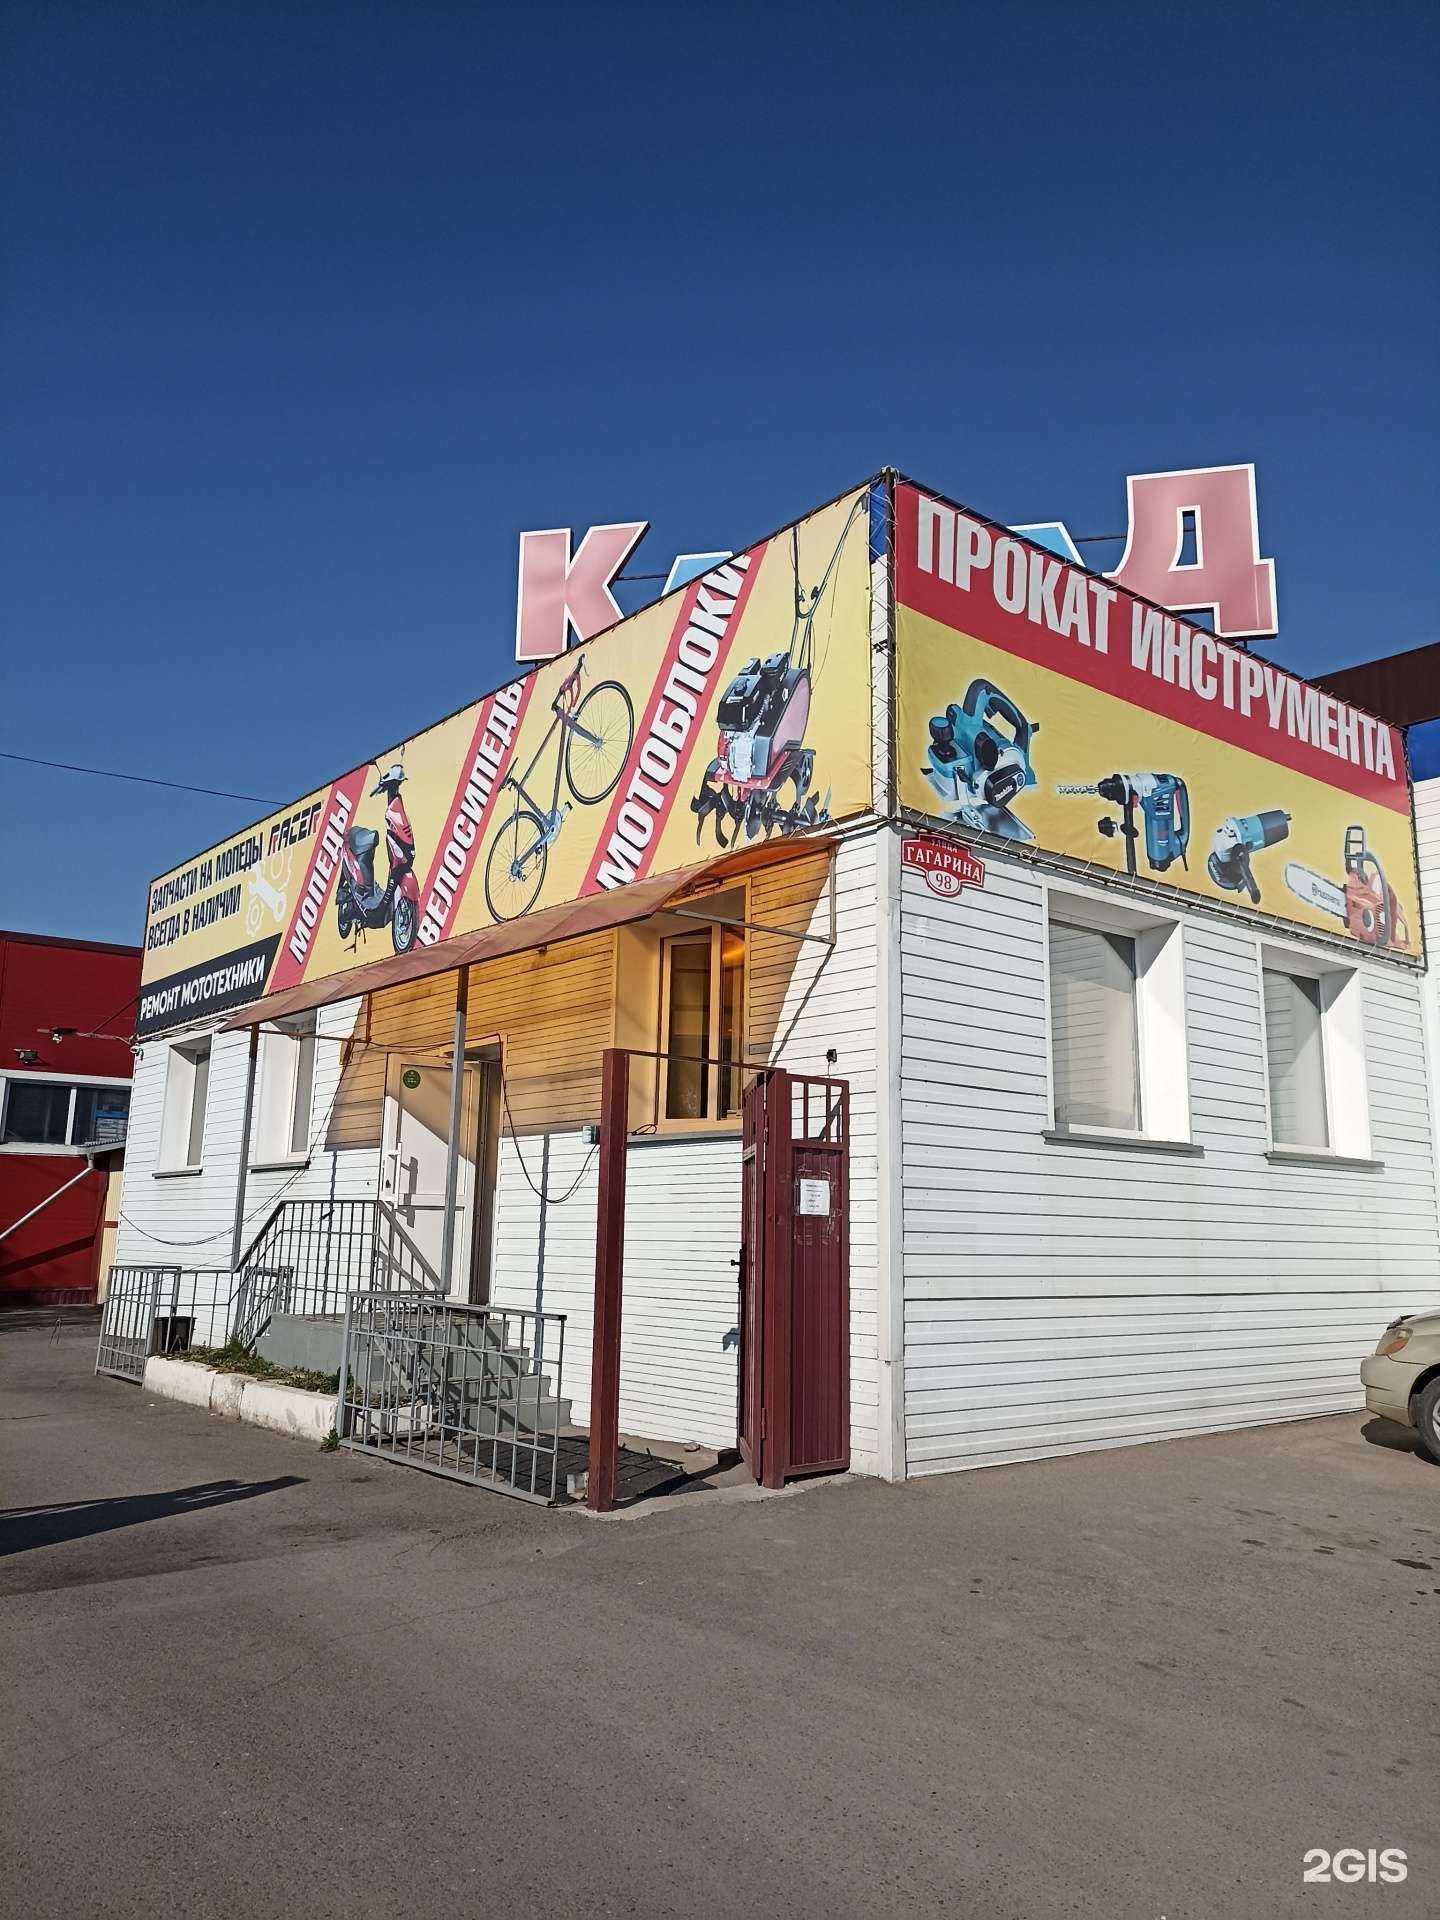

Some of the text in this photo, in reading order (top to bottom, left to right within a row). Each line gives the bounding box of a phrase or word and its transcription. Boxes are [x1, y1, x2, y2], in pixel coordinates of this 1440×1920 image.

[917, 494, 1396, 781] ПРОКАТ ИНСТРУМЕНТА
[596, 555, 752, 890] МОТОБЛОКИ
[151, 801, 322, 915] ЗАПЧАСТИ НА МОПЕДЫ RACER
[289, 790, 353, 964] МОПЕДЫ
[907, 847, 980, 881] ГАГАРИНА
[936, 873, 952, 889] 98
[147, 884, 242, 951] ВСЕГДА В НАЛИЧИИ
[140, 954, 266, 1021] РЕМОНТ МОТОТЕХНИКИ
